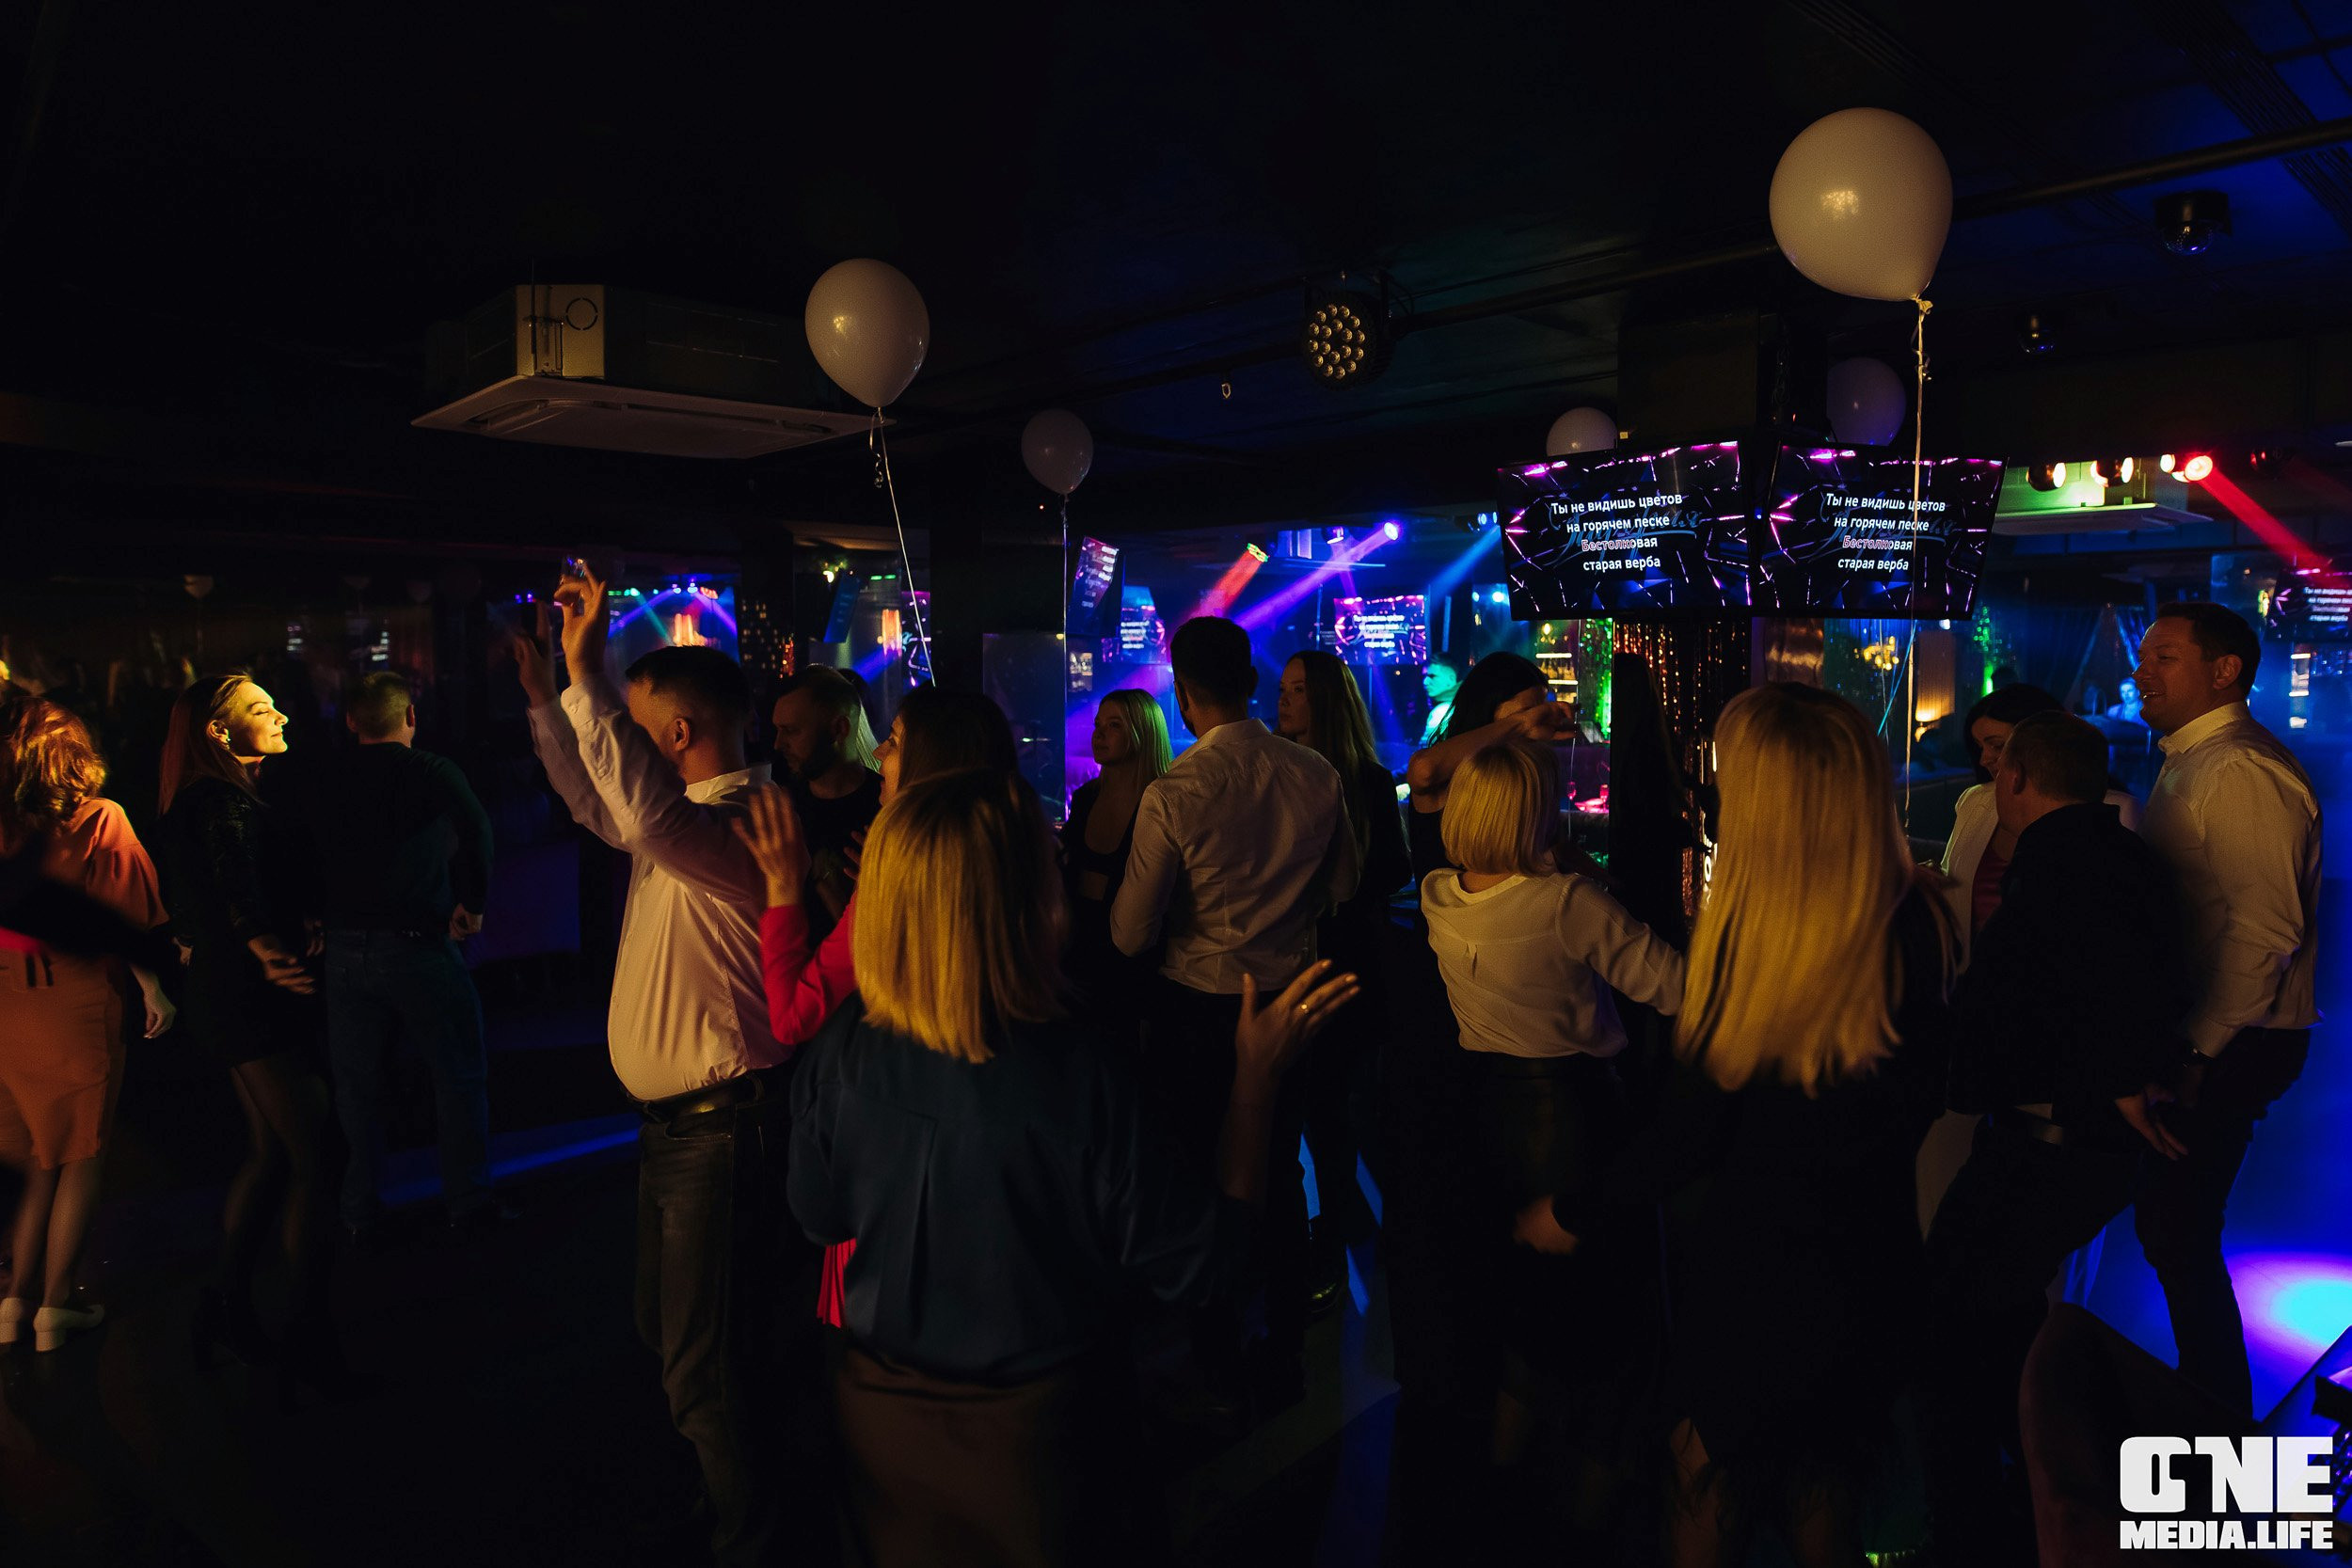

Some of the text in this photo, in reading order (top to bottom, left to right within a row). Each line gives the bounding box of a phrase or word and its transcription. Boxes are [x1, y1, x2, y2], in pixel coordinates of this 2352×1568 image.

[1551, 494, 1683, 515] Ты не видишь цветов
[1826, 493, 1842, 506] Ты
[1844, 497, 1859, 507] не
[1861, 498, 1906, 510] видишь
[1566, 522, 1581, 533] на
[1583, 517, 1631, 533] горячем
[1634, 515, 1670, 528] песке
[1834, 517, 1848, 528] на
[1850, 517, 1896, 531] горячем
[1581, 537, 1658, 552] Бестолковая
[1842, 535, 1913, 551] Бестолковая
[1582, 556, 1661, 573] старая верба
[1837, 558, 1909, 573] старая верба
